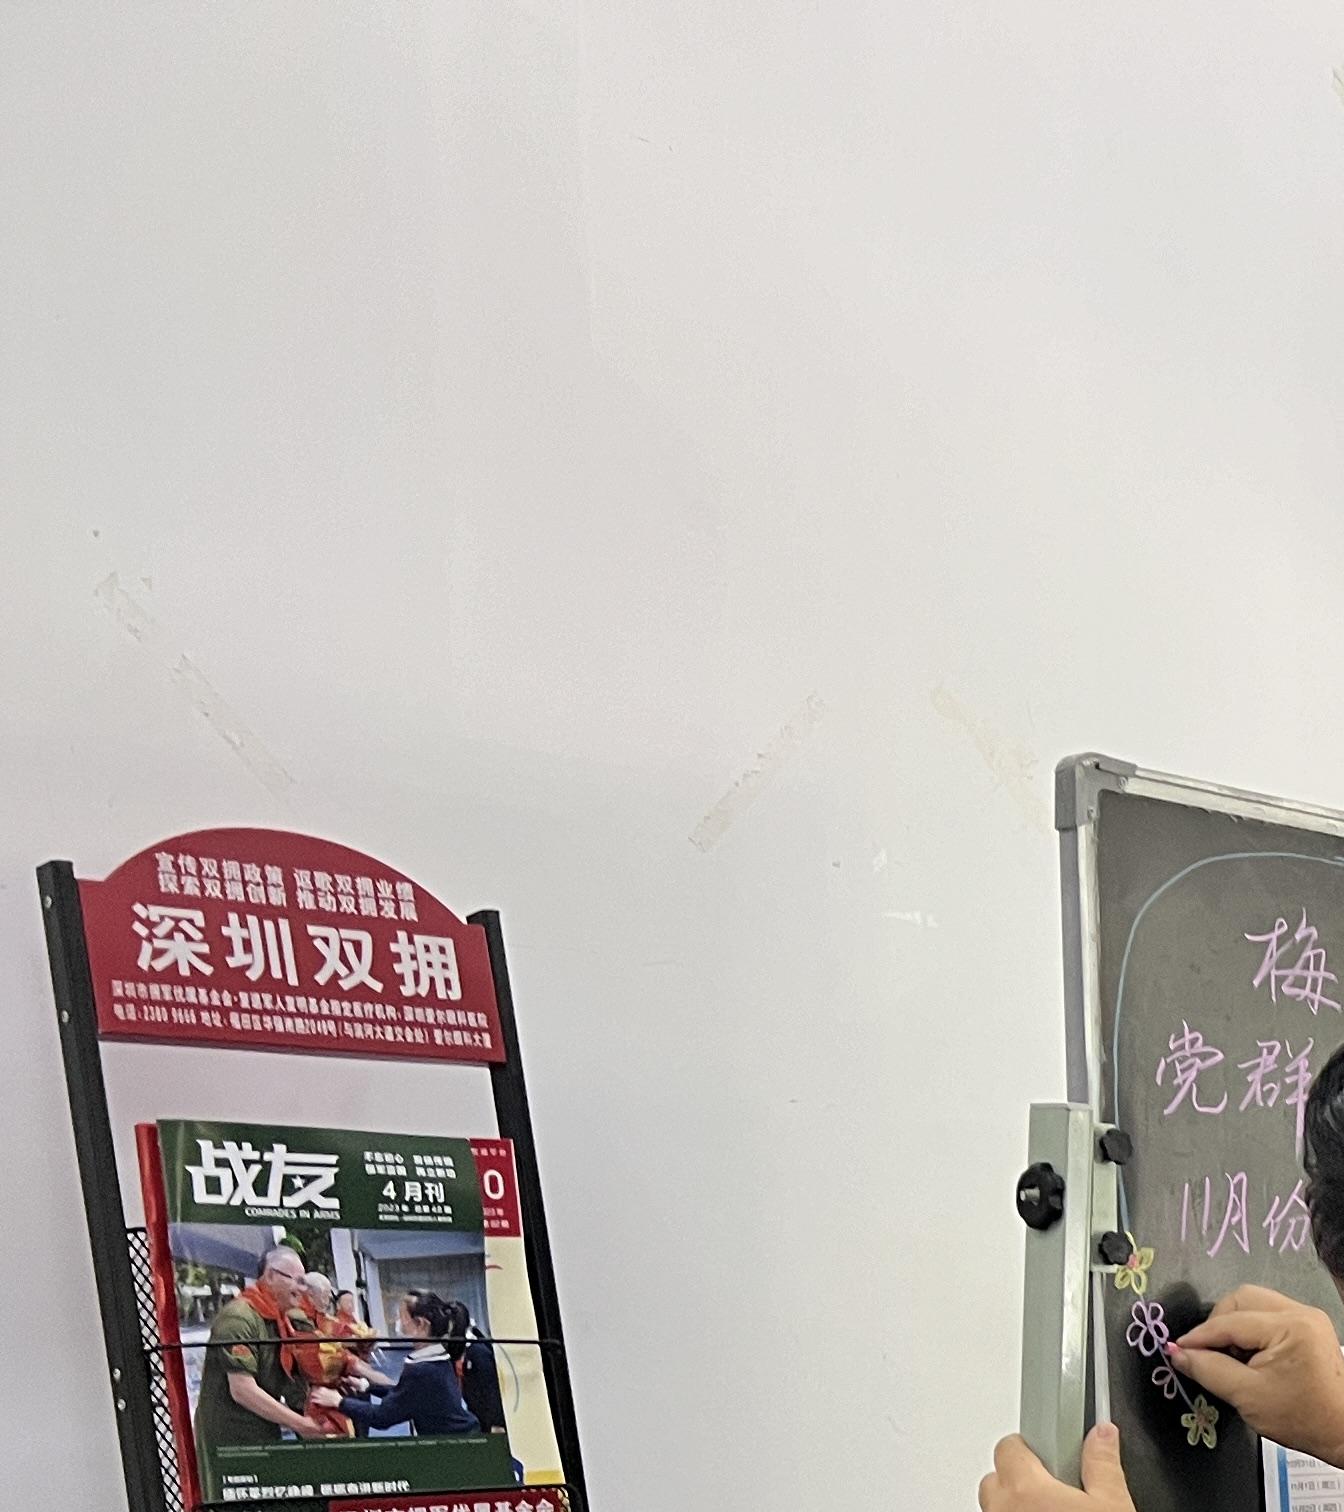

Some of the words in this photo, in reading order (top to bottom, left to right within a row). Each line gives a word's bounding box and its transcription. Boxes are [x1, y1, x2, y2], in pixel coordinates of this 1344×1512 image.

[131, 902, 463, 1001] 深圳双拥
[185, 1138, 341, 1211] 战友
[382, 1180, 445, 1204] 4月刊
